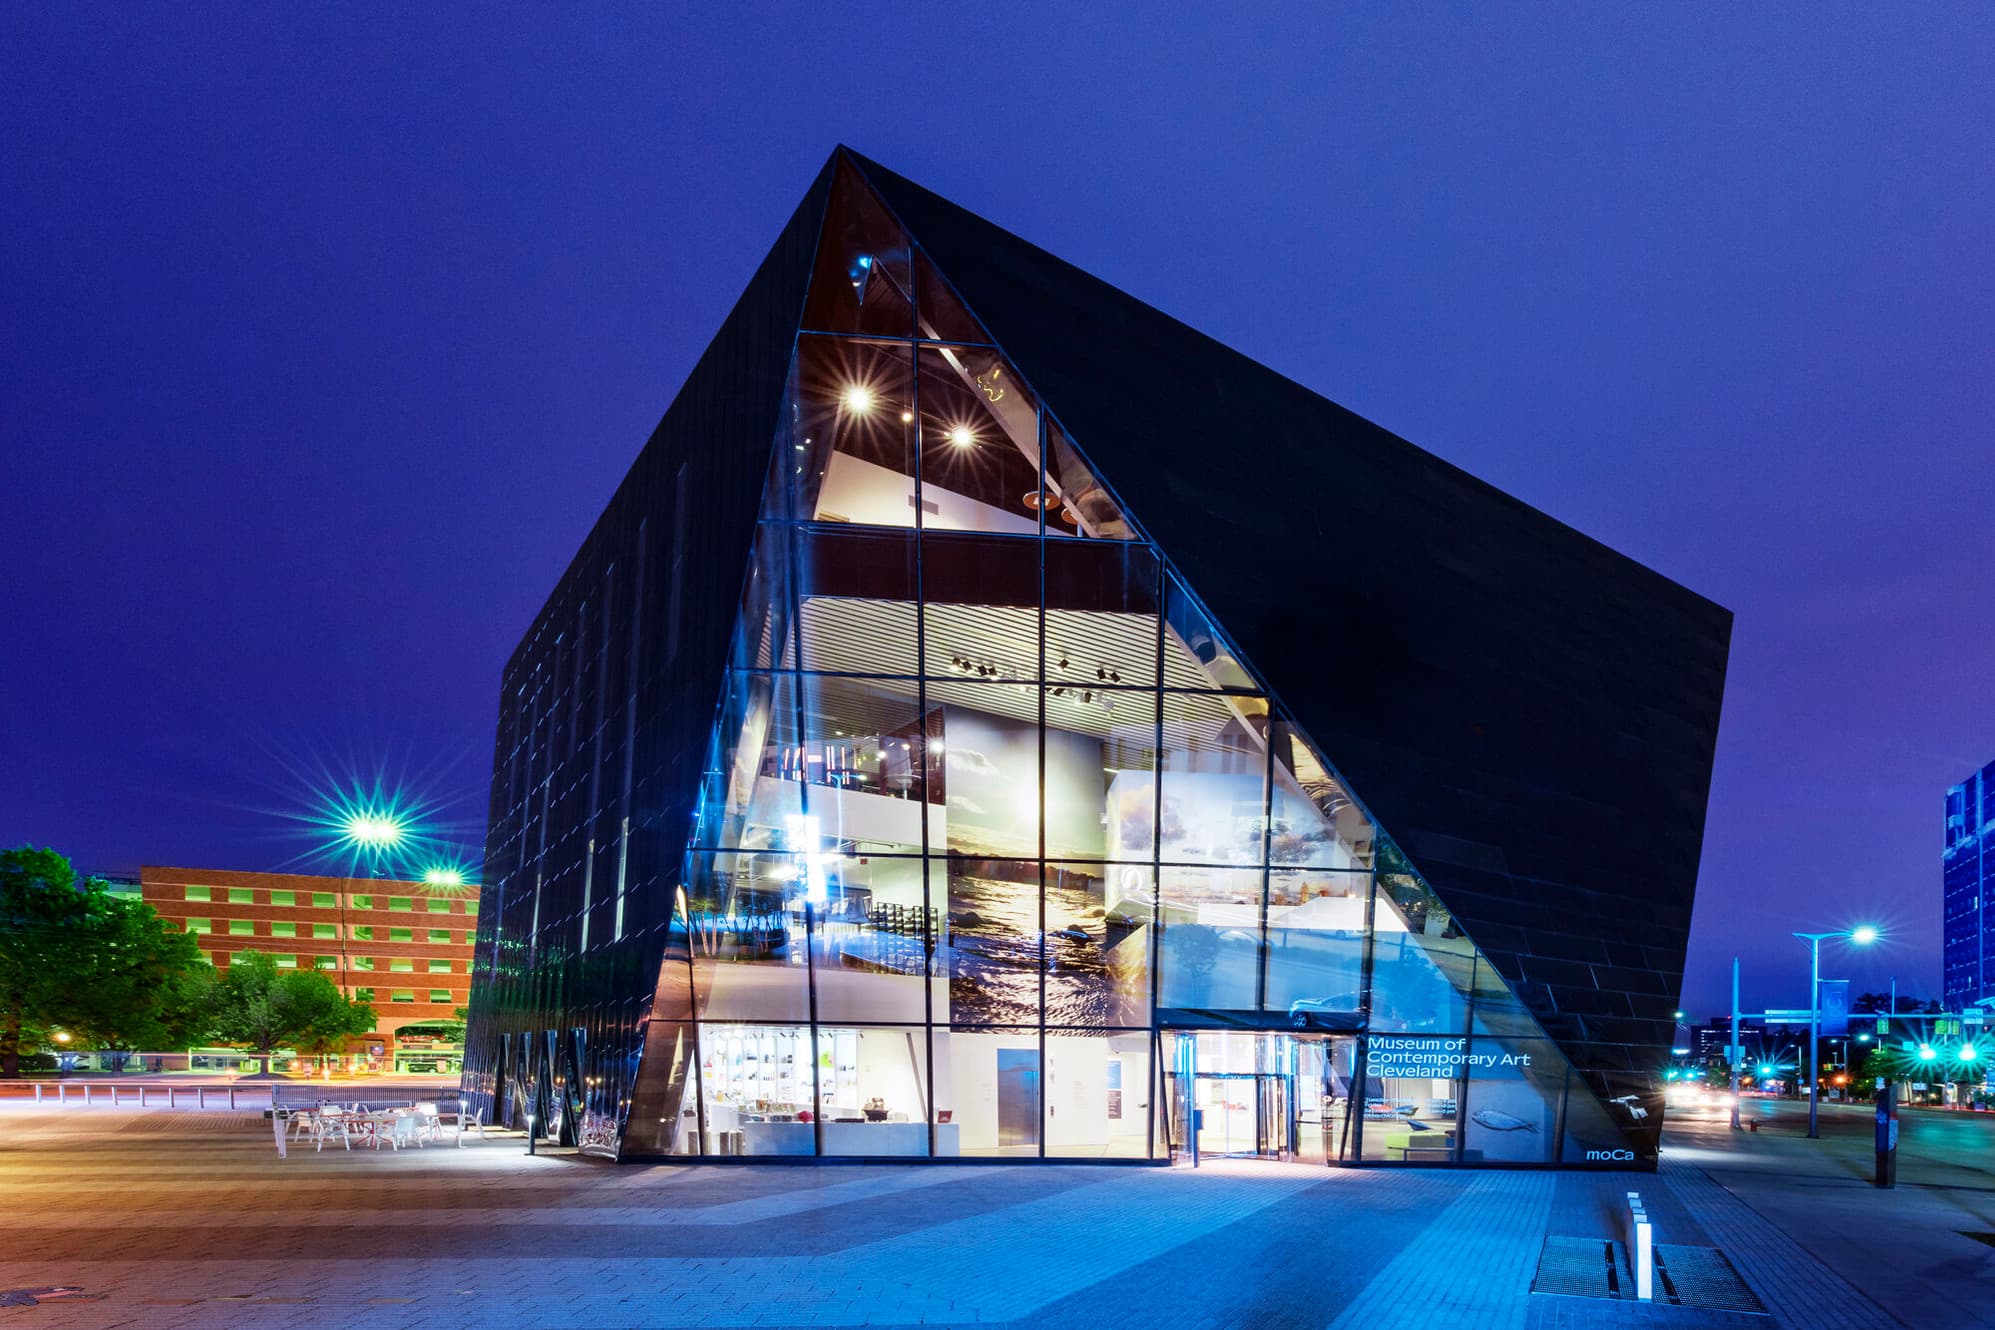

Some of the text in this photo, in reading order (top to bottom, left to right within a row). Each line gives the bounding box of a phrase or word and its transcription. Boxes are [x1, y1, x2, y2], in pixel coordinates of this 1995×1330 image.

[1367, 1036, 1466, 1051] Museum of
[1366, 1051, 1531, 1068] Contemporary Art
[1366, 1064, 1454, 1078] Cleveland
[1586, 1148, 1635, 1161] moCa
